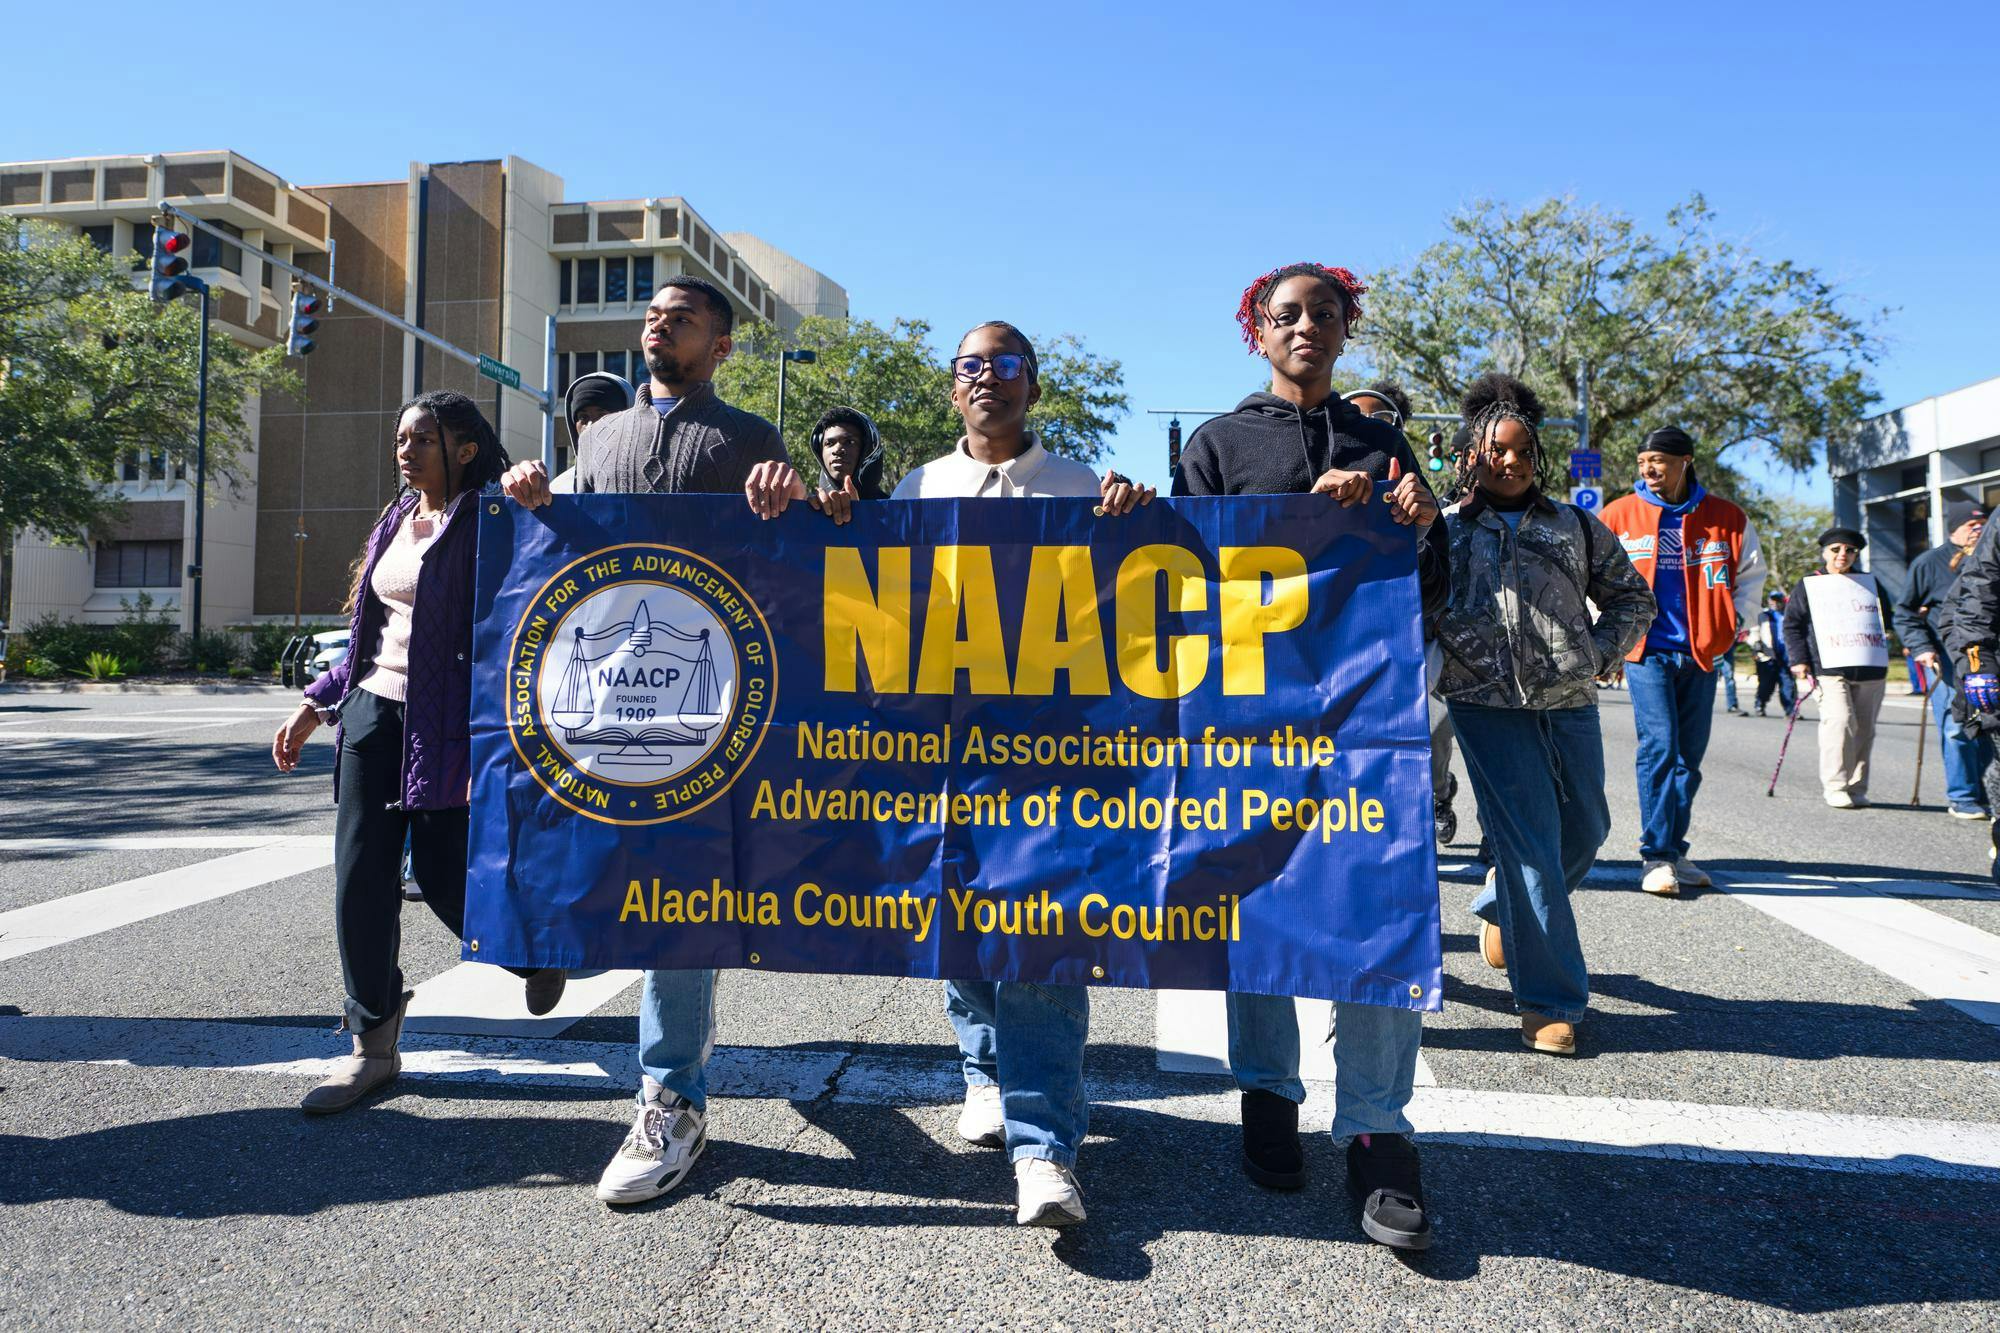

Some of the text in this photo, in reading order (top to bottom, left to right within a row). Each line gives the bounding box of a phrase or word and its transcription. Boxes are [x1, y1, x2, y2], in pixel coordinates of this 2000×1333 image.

[481, 356, 519, 385] University
[1582, 493, 1593, 506] P
[1703, 563, 1731, 589] 14
[823, 544, 1309, 699] NAACP
[516, 556, 765, 810] NATIONAL ASSOCIATION FOR THE ADVANCEMENT OF COLORED PEOPLE
[598, 667, 680, 688] NAACP
[616, 695, 657, 703] FOUNDED
[616, 707, 656, 722] 1909
[797, 721, 1335, 768] National Association for the
[750, 779, 1385, 843] Advancement of Colored People
[619, 878, 1241, 942] Alachua County Youth Council
